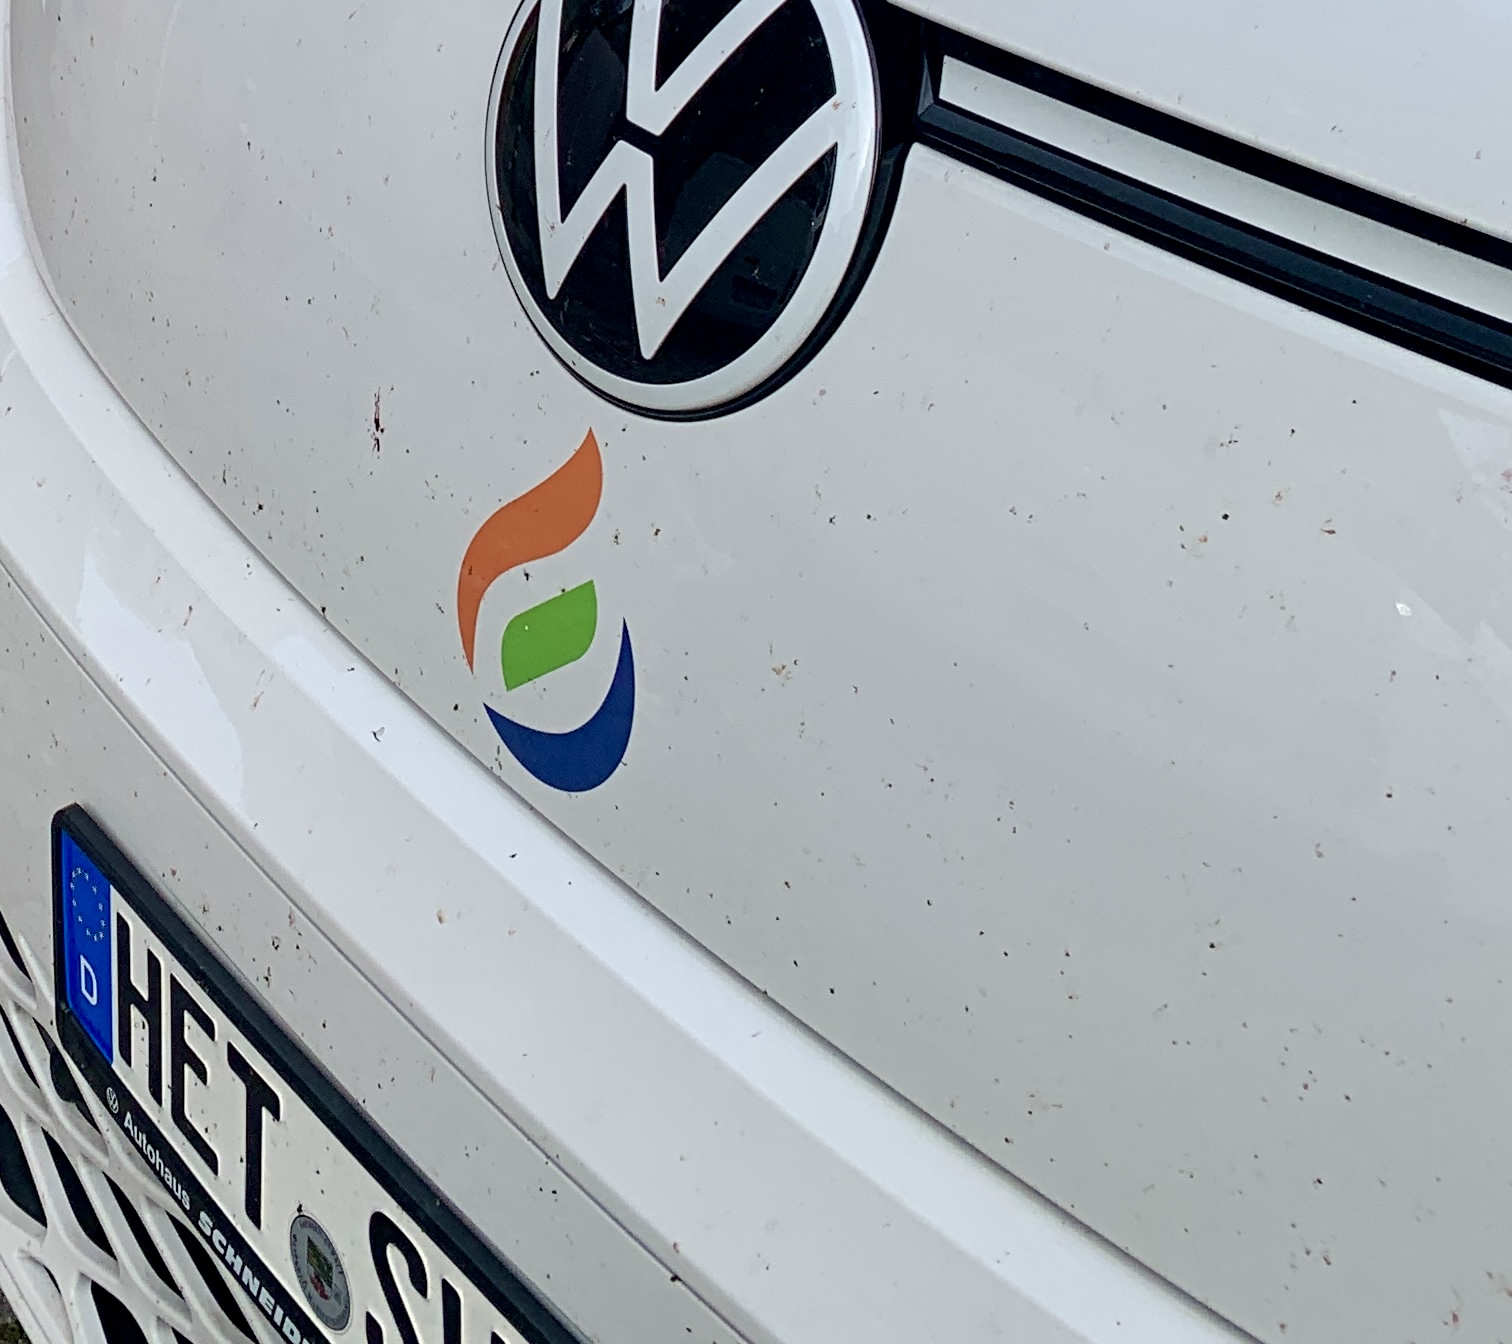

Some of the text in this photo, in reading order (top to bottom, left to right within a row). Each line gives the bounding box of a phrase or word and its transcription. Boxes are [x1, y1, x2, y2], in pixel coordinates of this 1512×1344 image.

[79, 953, 98, 1006] D
[116, 911, 282, 1231] HET
[123, 1111, 310, 1344] Autohaus SCHNEID
